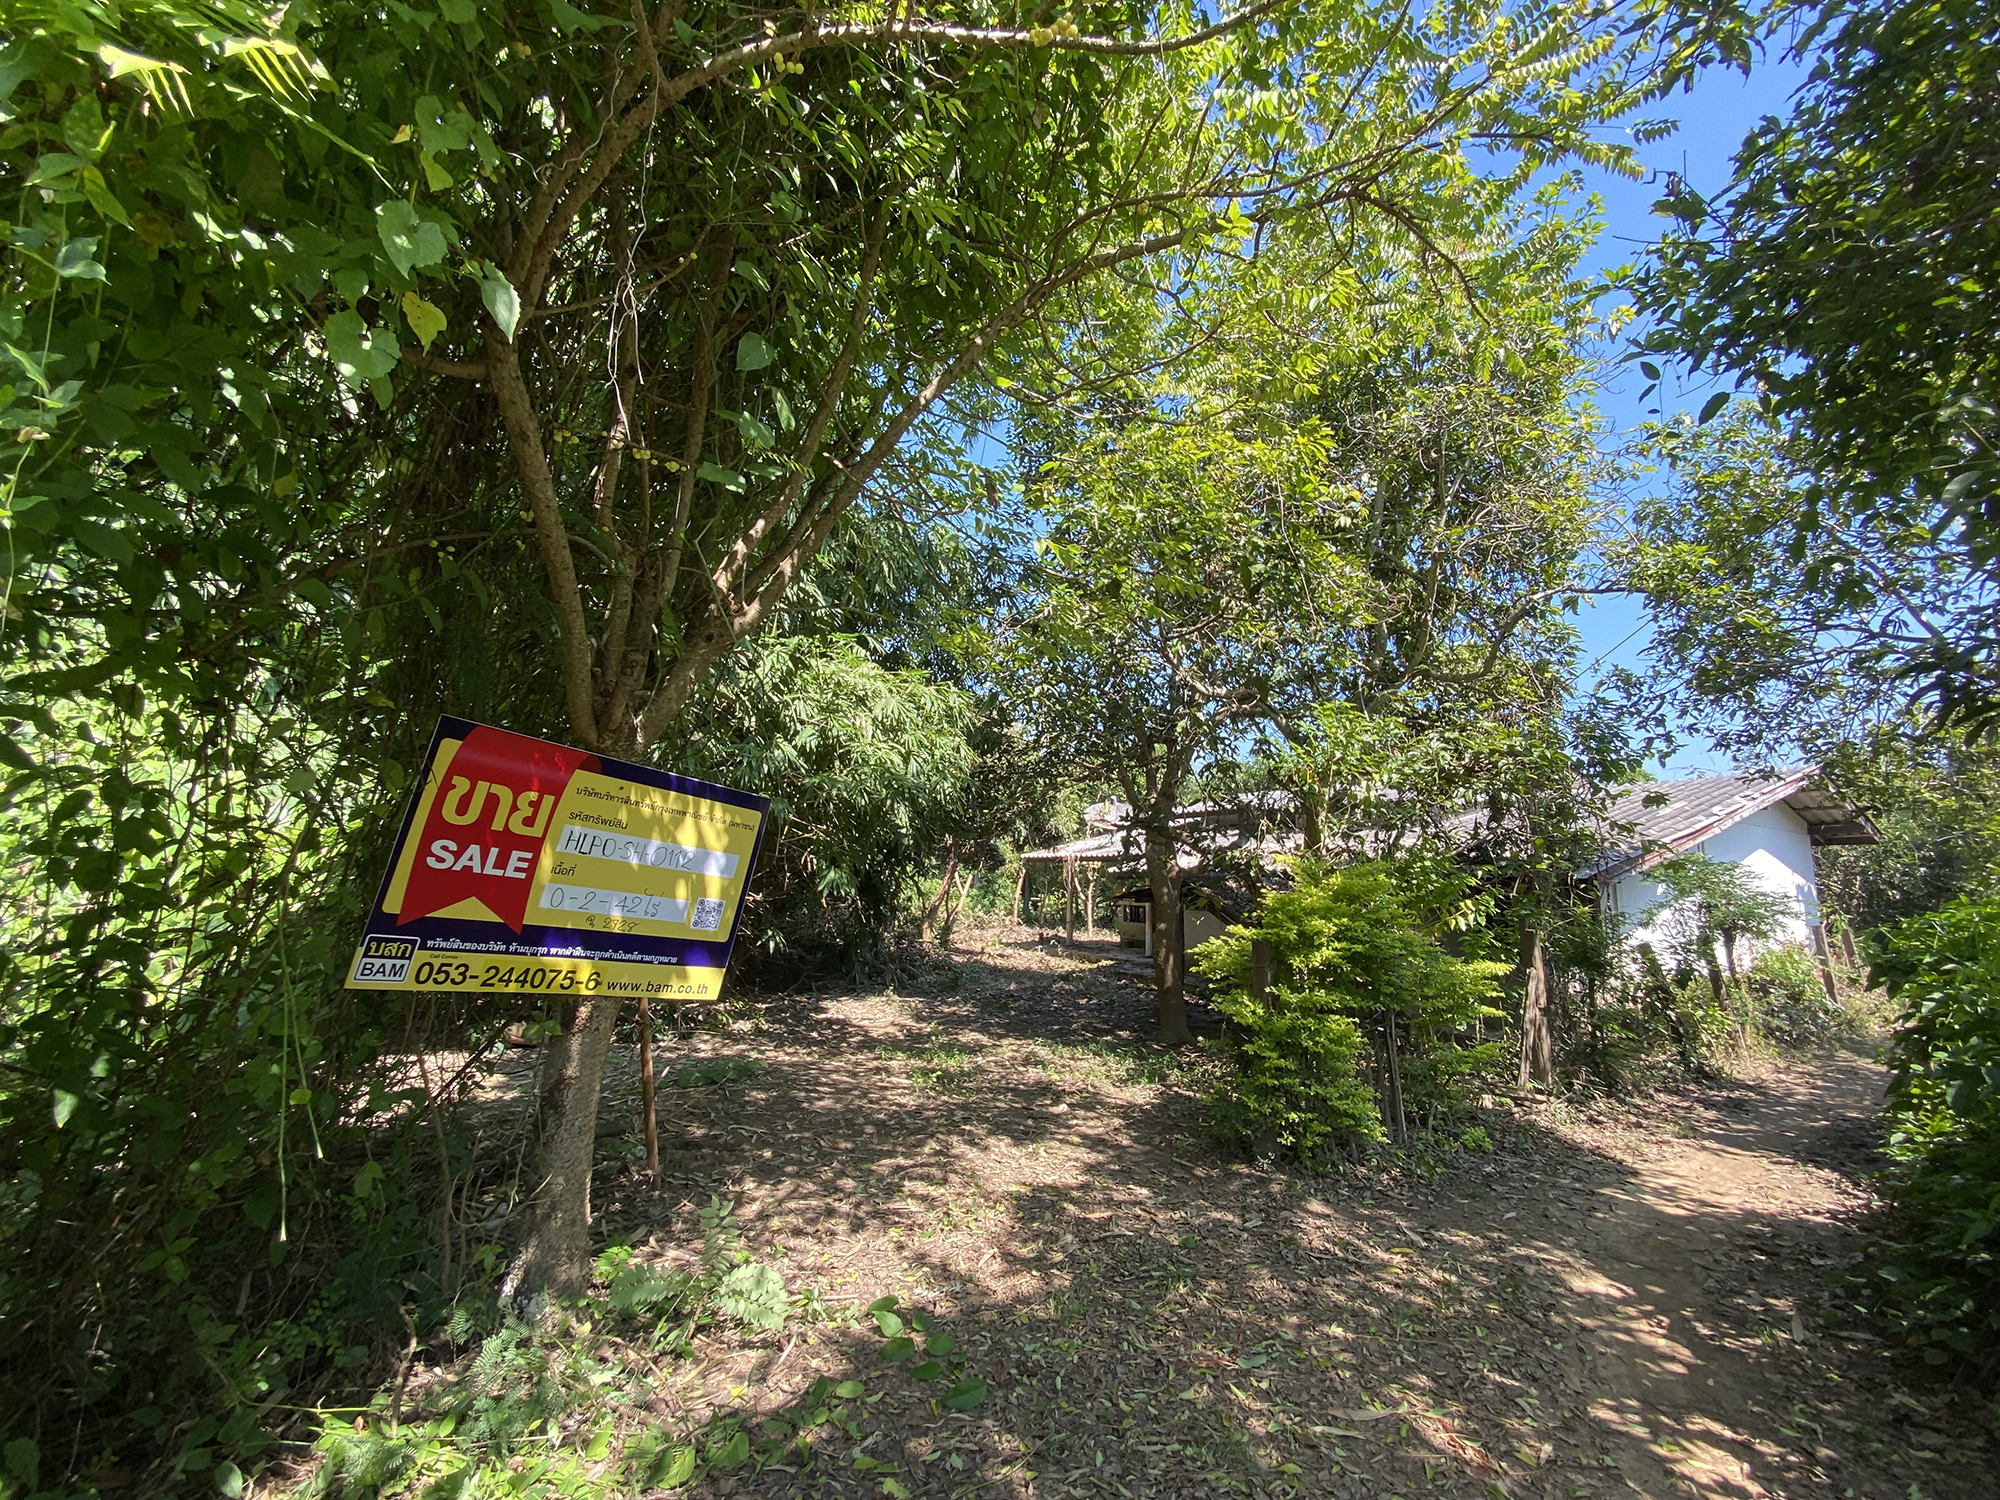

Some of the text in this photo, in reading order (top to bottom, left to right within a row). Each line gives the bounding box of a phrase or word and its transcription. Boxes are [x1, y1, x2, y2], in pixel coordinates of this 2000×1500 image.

[441, 775, 555, 838] ขาย
[568, 810, 629, 830] รหัสทรัพย์สิน
[426, 839, 533, 879] SALE
[550, 861, 577, 877] เนื้อที่
[367, 941, 412, 958] บสก
[426, 938, 507, 951] ทรัพย์สินของบริษัท
[508, 943, 547, 957] ห้ามบุกรุก
[360, 962, 406, 978] BAM
[415, 961, 602, 992] 053-244075-6
[607, 981, 709, 995] www.bam.co.th
